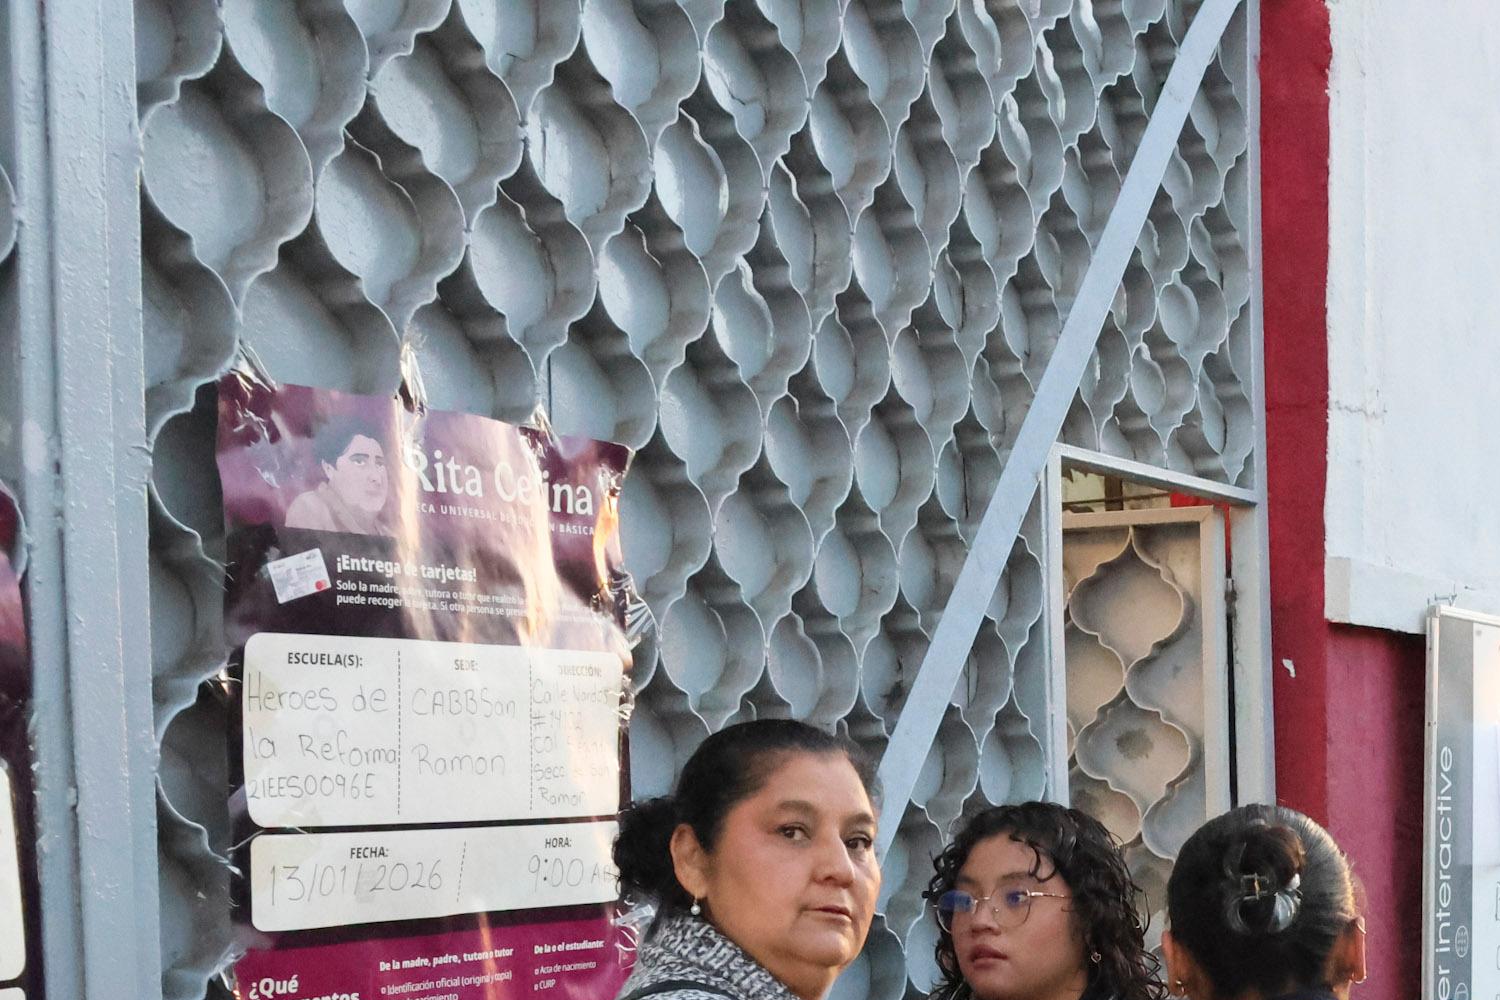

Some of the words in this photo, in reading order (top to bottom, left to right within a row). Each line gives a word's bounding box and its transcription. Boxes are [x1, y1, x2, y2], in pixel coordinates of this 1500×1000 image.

[404, 445, 483, 498] Rita
[494, 461, 594, 516] Ceina
[440, 504, 497, 522] UNIVERSAL
[336, 554, 401, 578] ¡Entrega
[420, 564, 477, 583] tarjetas!
[336, 579, 357, 592] Solo
[359, 580, 368, 592] la
[336, 594, 366, 606] puede
[367, 595, 402, 609] recoger
[449, 602, 466, 612] otra
[496, 607, 505, 615] se
[287, 651, 363, 669] ESCUELA(S):
[248, 671, 338, 712] Heroes
[352, 684, 388, 713] de
[249, 726, 277, 759] la
[298, 729, 397, 767] Reforma
[411, 743, 506, 776] Ramon
[350, 846, 389, 860] FECHA:
[544, 837, 572, 849] HORA:
[1435, 745, 1453, 954] interactive
[528, 854, 584, 893] 9:00
[379, 960, 391, 972] De
[392, 959, 401, 970] la
[402, 956, 432, 970] madre,
[433, 953, 461, 968] padre,
[495, 947, 514, 958] tutor
[534, 945, 544, 955] De
[544, 943, 551, 953] la
[557, 942, 565, 952] el
[249, 974, 299, 1000] ¿Qué
[387, 979, 435, 996] Identificación
[436, 976, 460, 989] oficial
